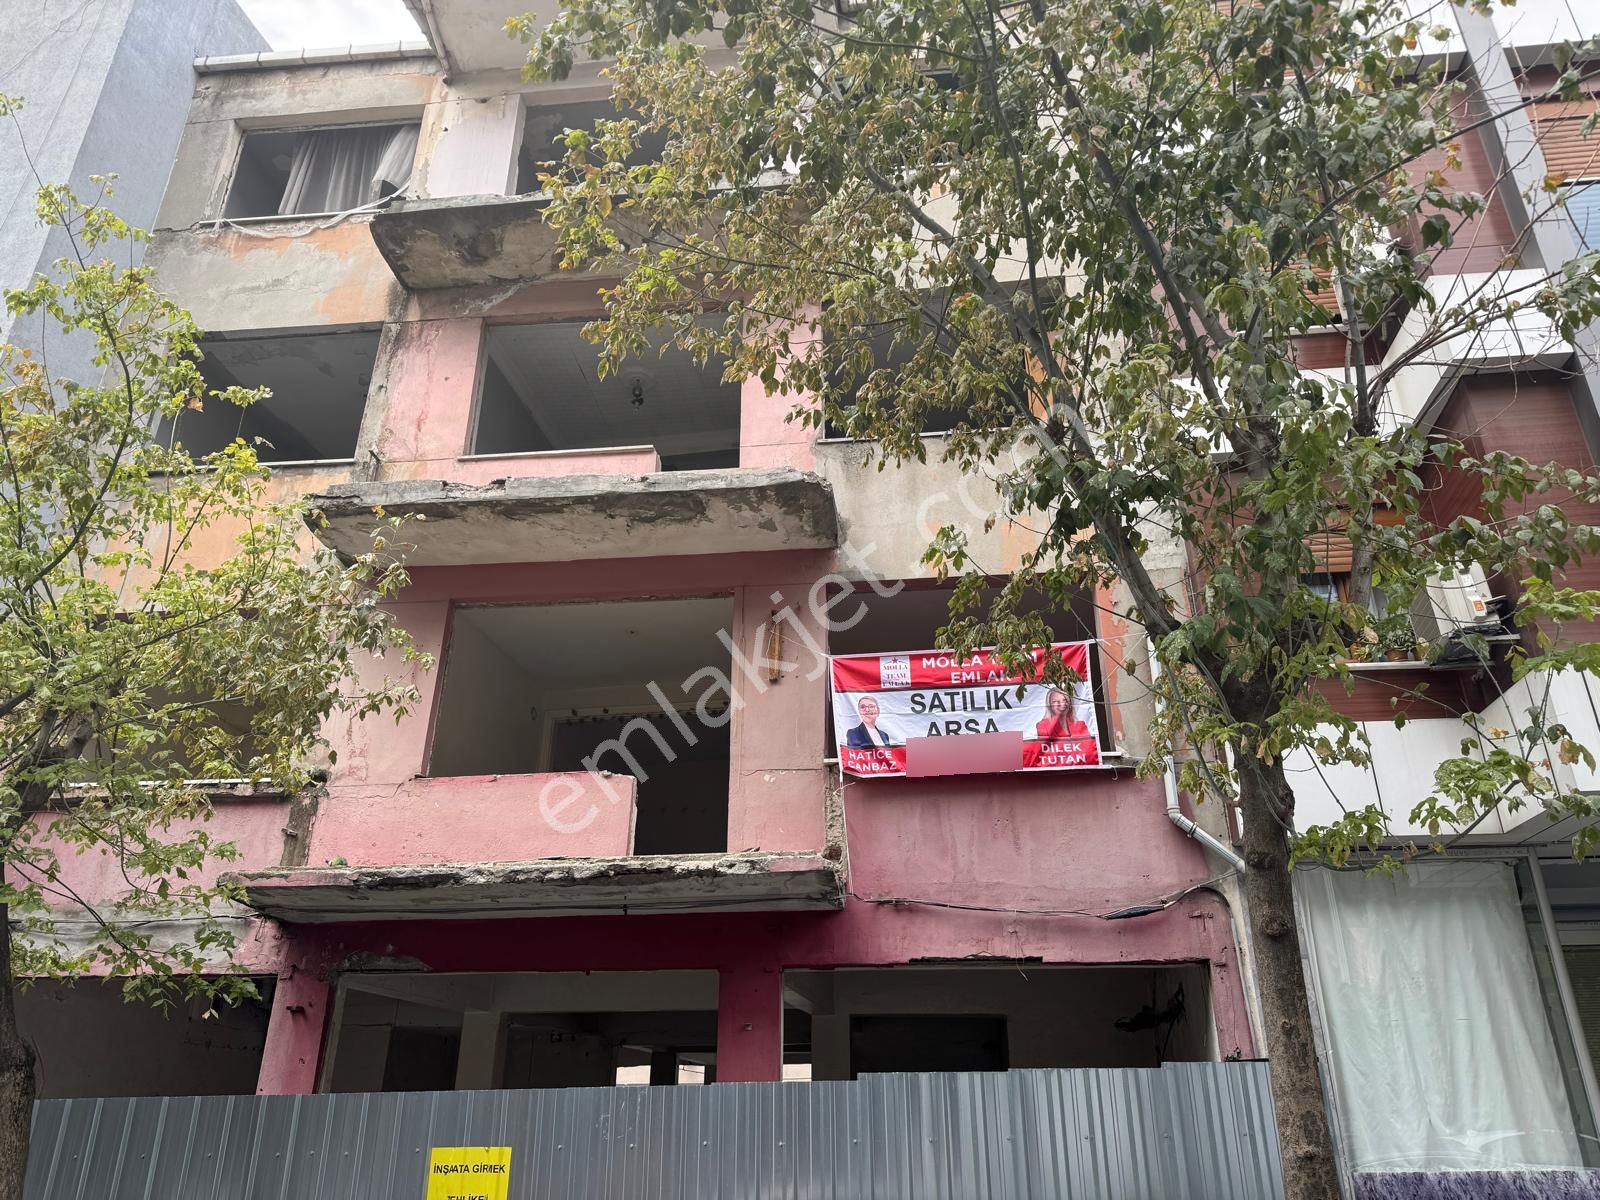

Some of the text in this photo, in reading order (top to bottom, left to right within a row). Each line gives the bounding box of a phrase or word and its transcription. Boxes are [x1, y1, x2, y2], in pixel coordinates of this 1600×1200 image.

[922, 654, 983, 669] MOLLA
[910, 688, 1013, 714] SATILIK
[927, 718, 999, 737] ARSA
[1041, 742, 1082, 753] DİLEK
[849, 749, 893, 761] HATİCE
[1039, 753, 1087, 765] TUTAN
[847, 760, 897, 774] CANBAZ
[433, 1162, 470, 1176] İNŞAATA
